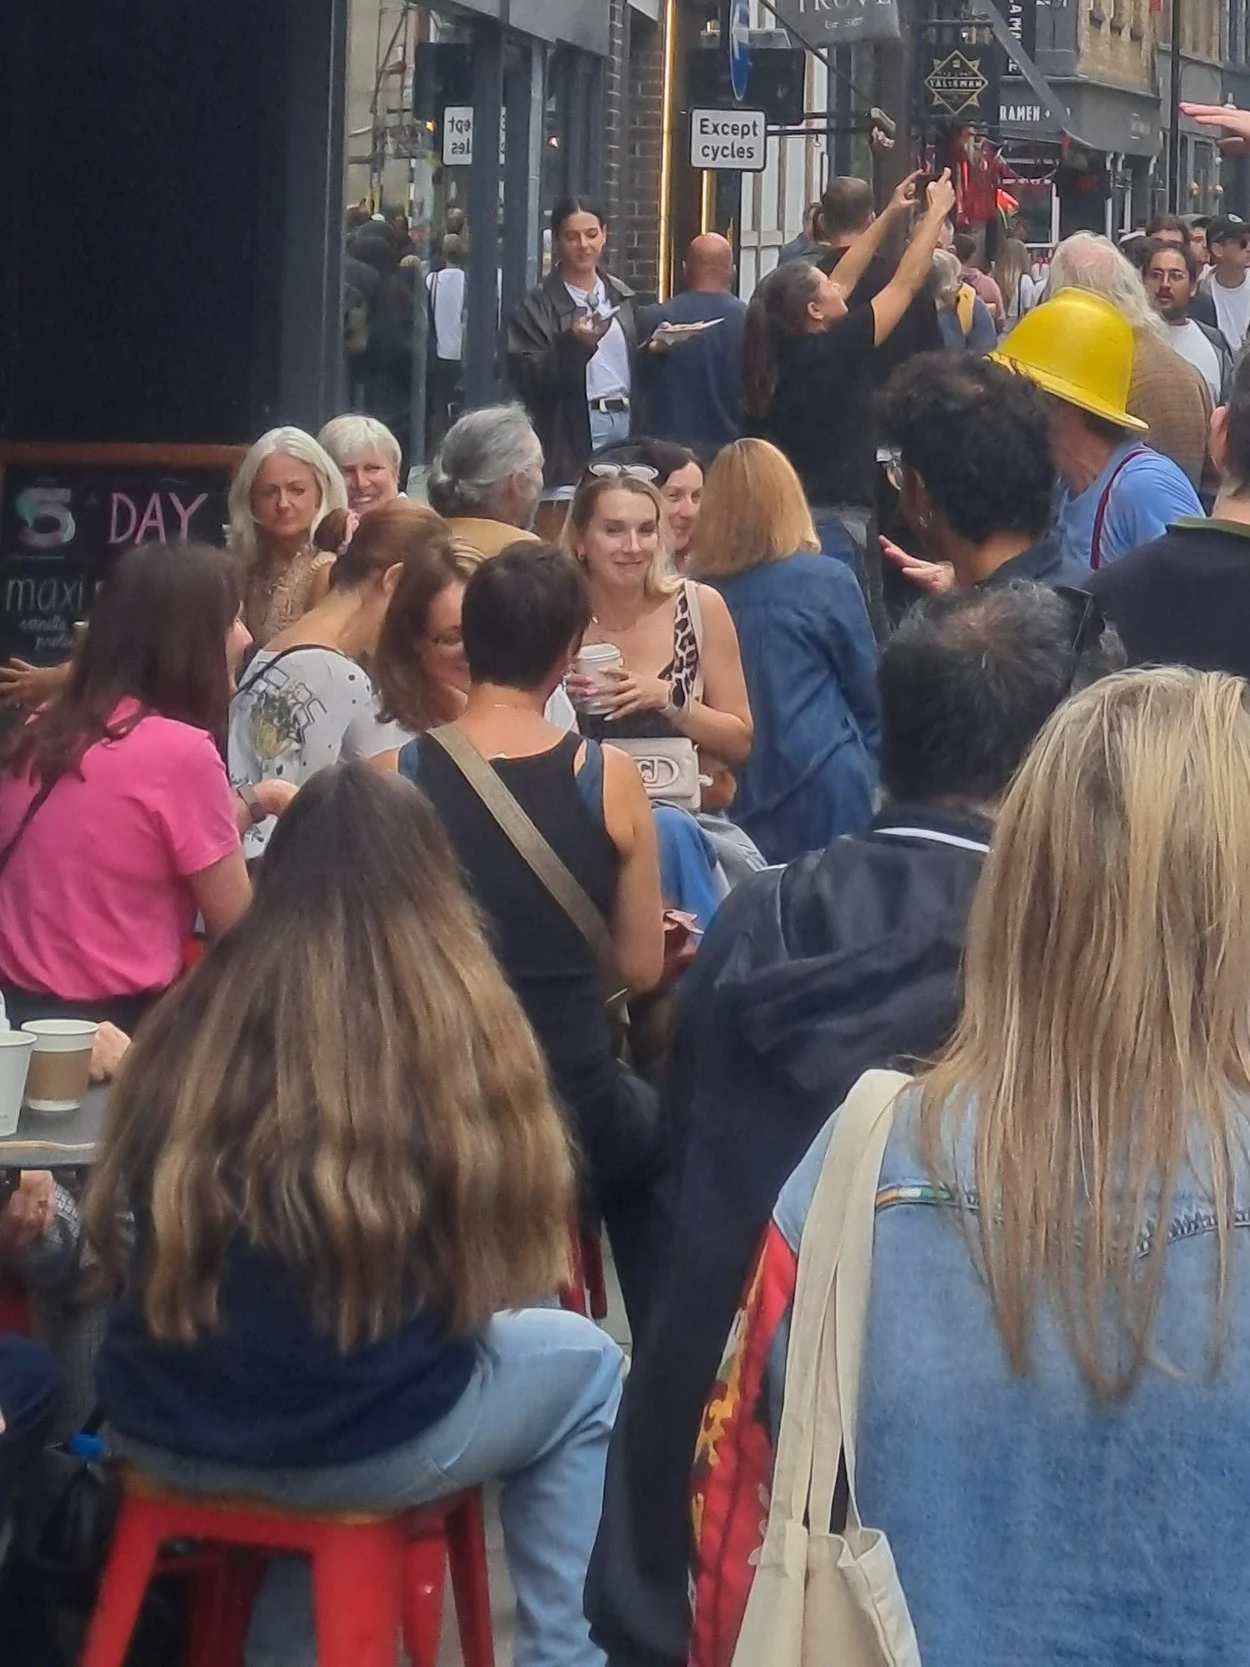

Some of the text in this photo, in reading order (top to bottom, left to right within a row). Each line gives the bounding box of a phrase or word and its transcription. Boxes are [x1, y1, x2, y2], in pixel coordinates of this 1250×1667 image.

[999, 105, 1040, 121] RAMEN
[700, 118, 758, 140] Except
[701, 142, 755, 162] cycles
[107, 491, 210, 546] DAY
[6, 574, 86, 613] maxi
